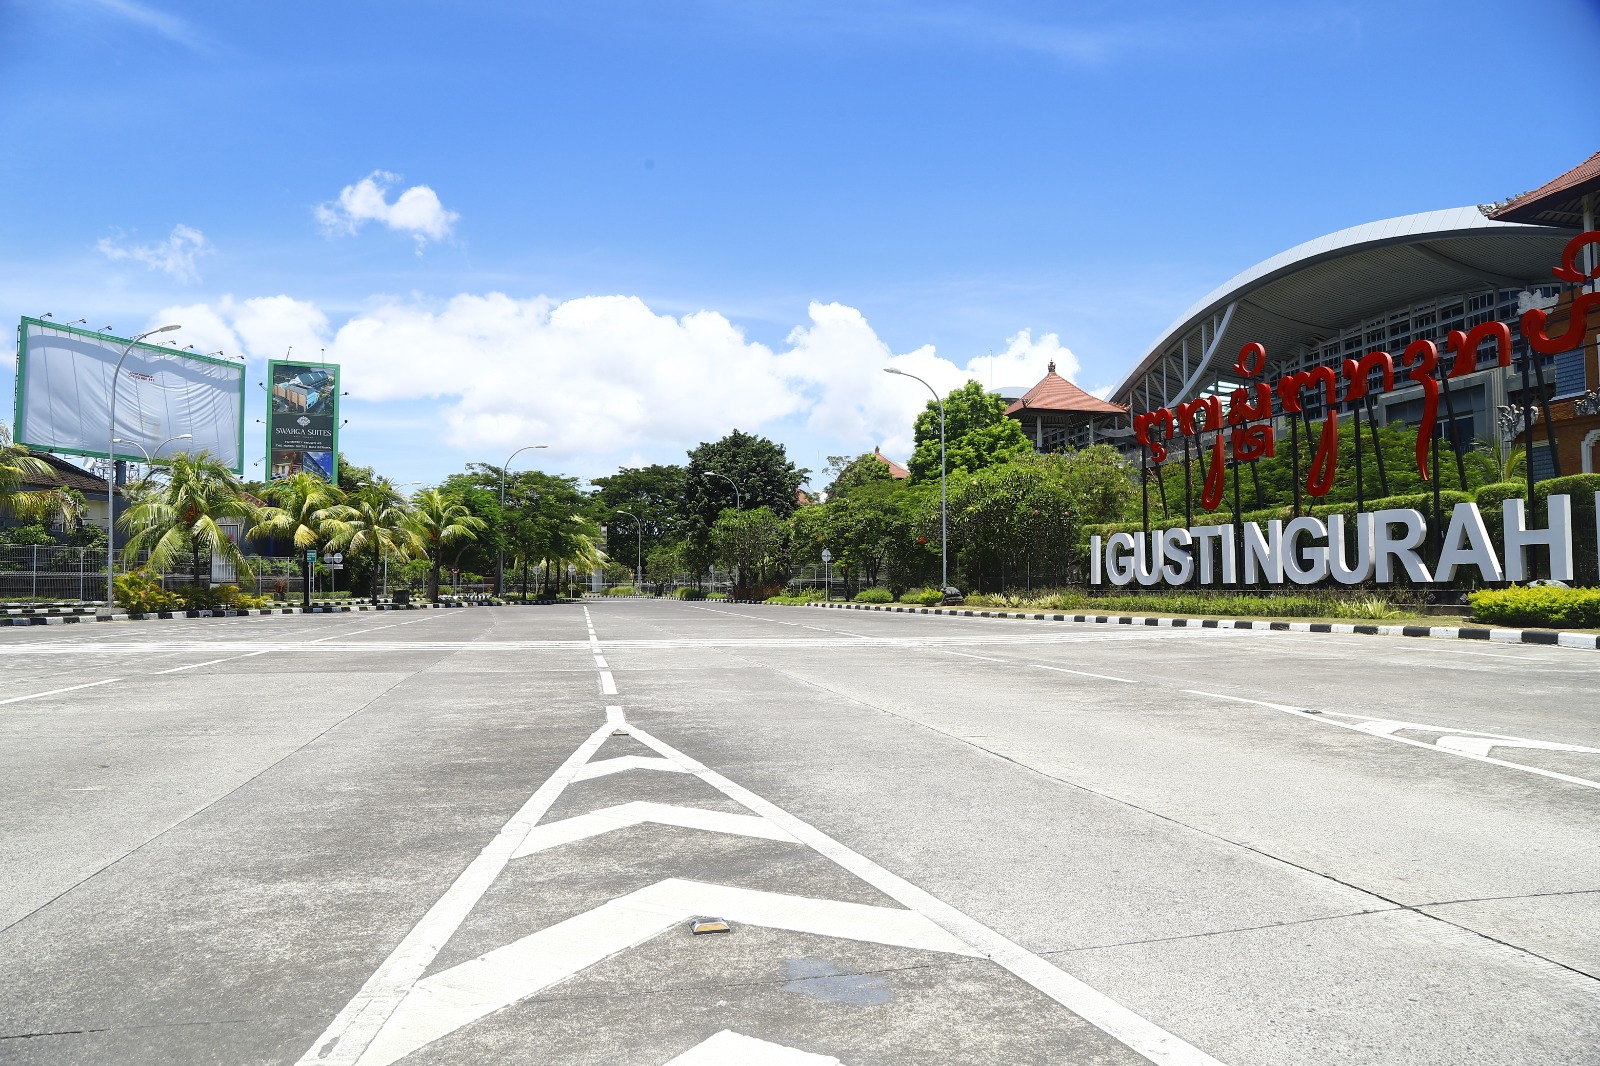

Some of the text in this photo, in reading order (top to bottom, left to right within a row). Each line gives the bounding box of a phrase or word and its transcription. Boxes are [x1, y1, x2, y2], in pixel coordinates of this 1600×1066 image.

[275, 427, 332, 437] SWARGA SUITES
[1090, 535, 1101, 585] I
[1244, 494, 1573, 584] NGURAH
